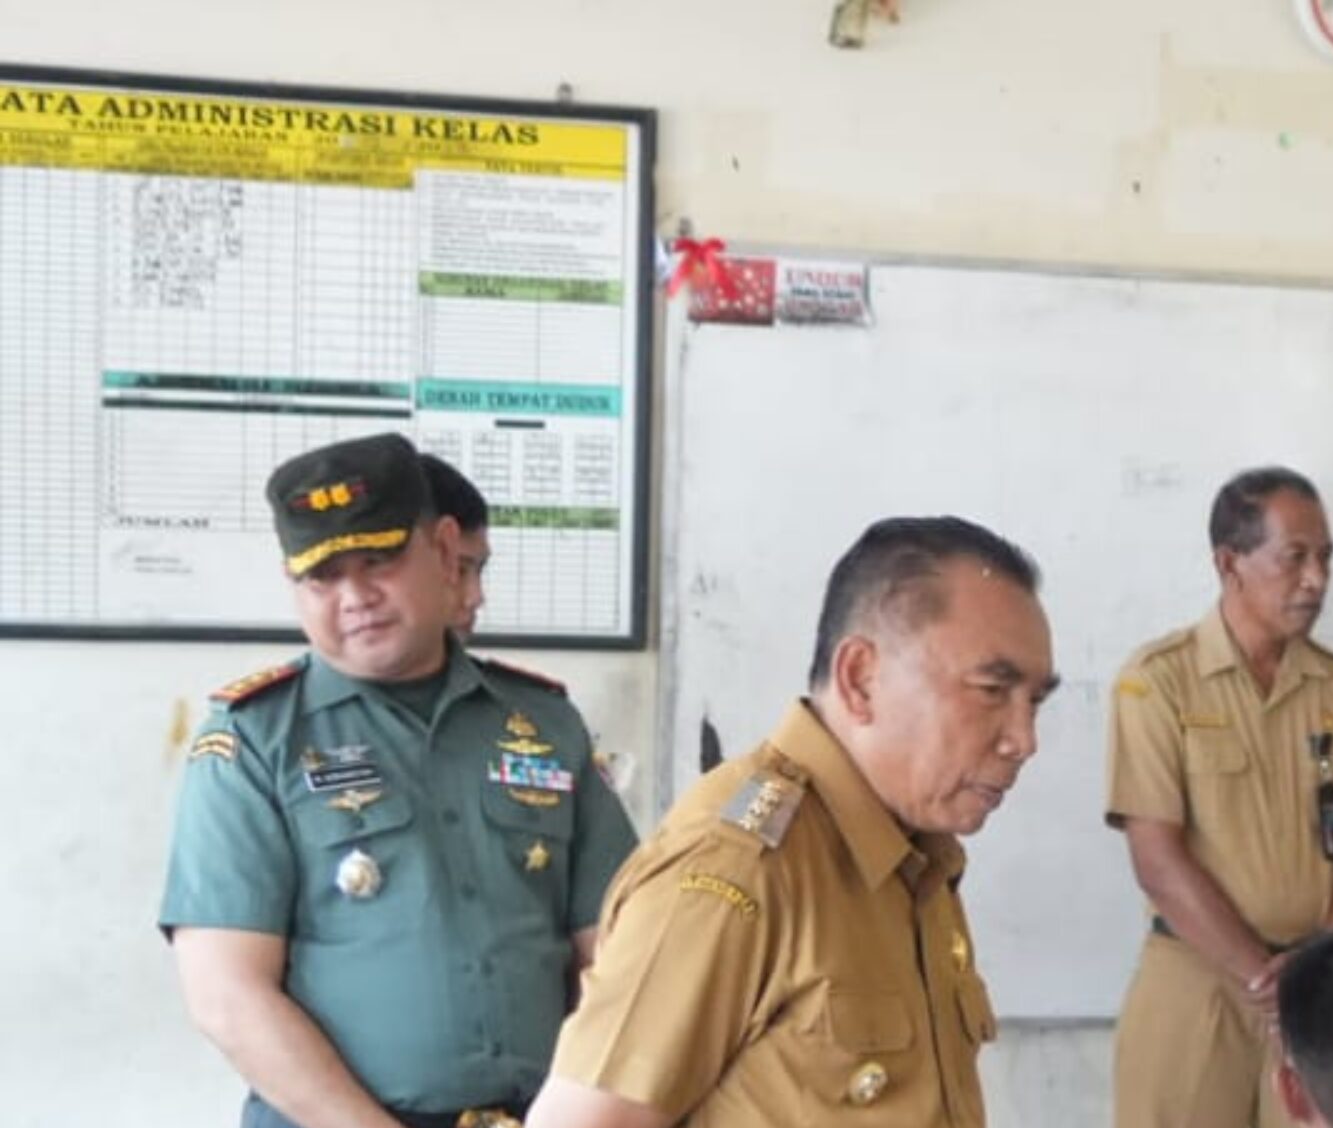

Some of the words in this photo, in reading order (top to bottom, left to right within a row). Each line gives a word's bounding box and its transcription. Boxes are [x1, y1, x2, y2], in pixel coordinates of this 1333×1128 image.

[67, 118, 148, 135] TAHUN
[155, 125, 290, 143] PELAJARAN
[97, 97, 397, 137] ADMINISTRASI
[411, 117, 540, 146] KELAS
